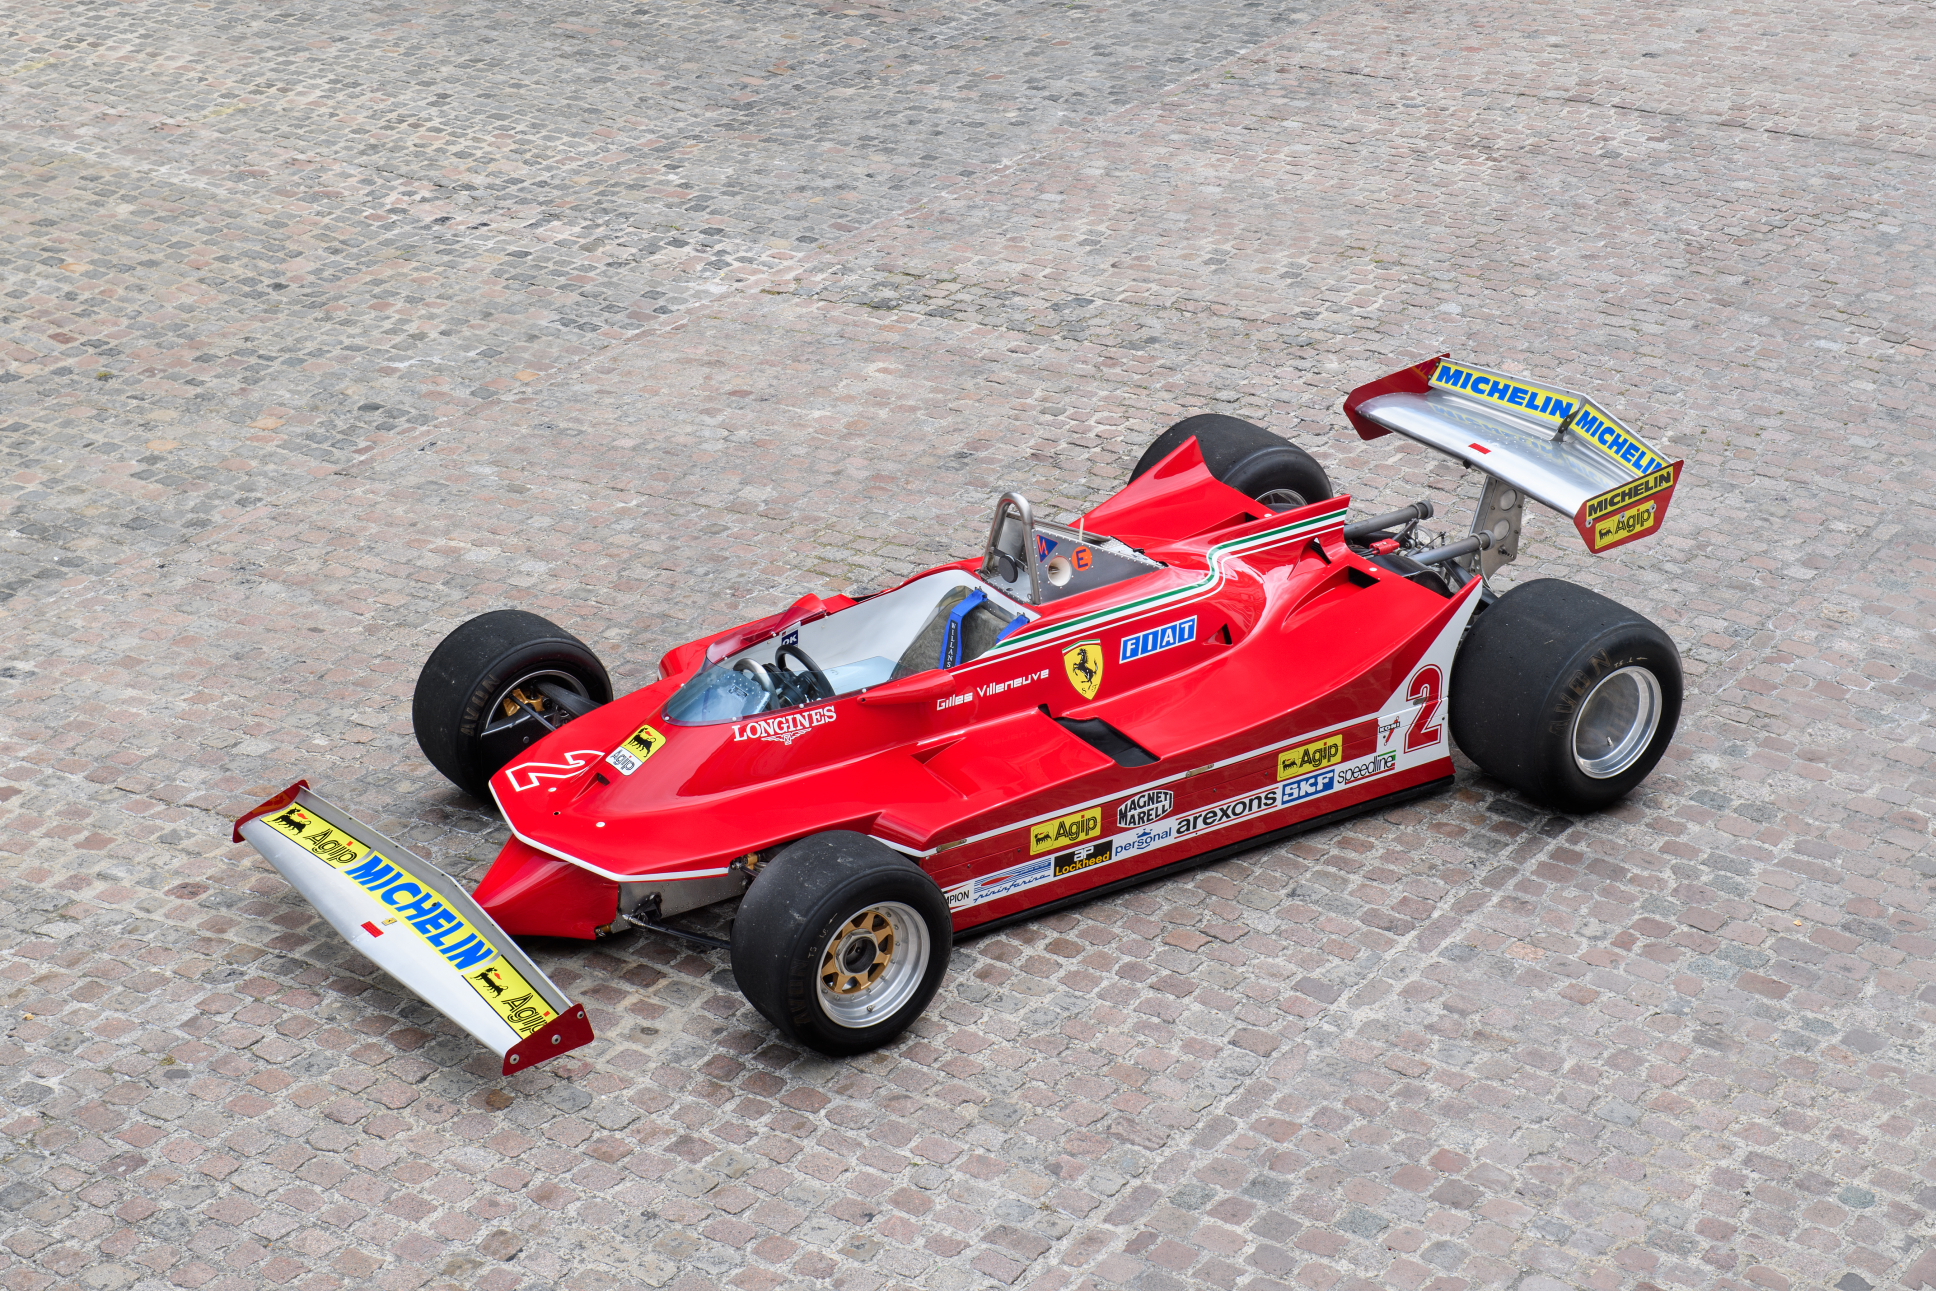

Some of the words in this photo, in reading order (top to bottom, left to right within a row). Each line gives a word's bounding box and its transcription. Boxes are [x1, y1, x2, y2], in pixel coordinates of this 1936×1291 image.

[1435, 364, 1575, 420] MICHELIN
[1588, 470, 1672, 518] MICHELIN
[1614, 508, 1651, 536] Agip
[1076, 548, 1089, 569] E
[946, 622, 957, 668] WILLANS
[1125, 620, 1194, 656] FIAT
[936, 690, 974, 711] Gilles
[976, 668, 1050, 698] Villeneuve
[460, 673, 501, 738] AVON
[1404, 663, 1443, 754] 2
[732, 705, 837, 742] LONGINES
[1379, 721, 1400, 734] KONI
[609, 749, 635, 771] Agip
[1299, 741, 1339, 768] Agip
[1337, 754, 1394, 785] speedline
[505, 749, 606, 792] 2
[1282, 771, 1334, 801] SKF
[1118, 790, 1173, 816] MAGNETI
[1118, 800, 1173, 826] MARELLI
[1175, 790, 1278, 835] arexons
[1054, 814, 1098, 842] Agip
[1115, 826, 1172, 857] personal
[304, 826, 358, 866] Agip
[1055, 851, 1110, 876] Lockheed
[973, 874, 1051, 904] pininfarina
[344, 854, 494, 971] MICHELIN
